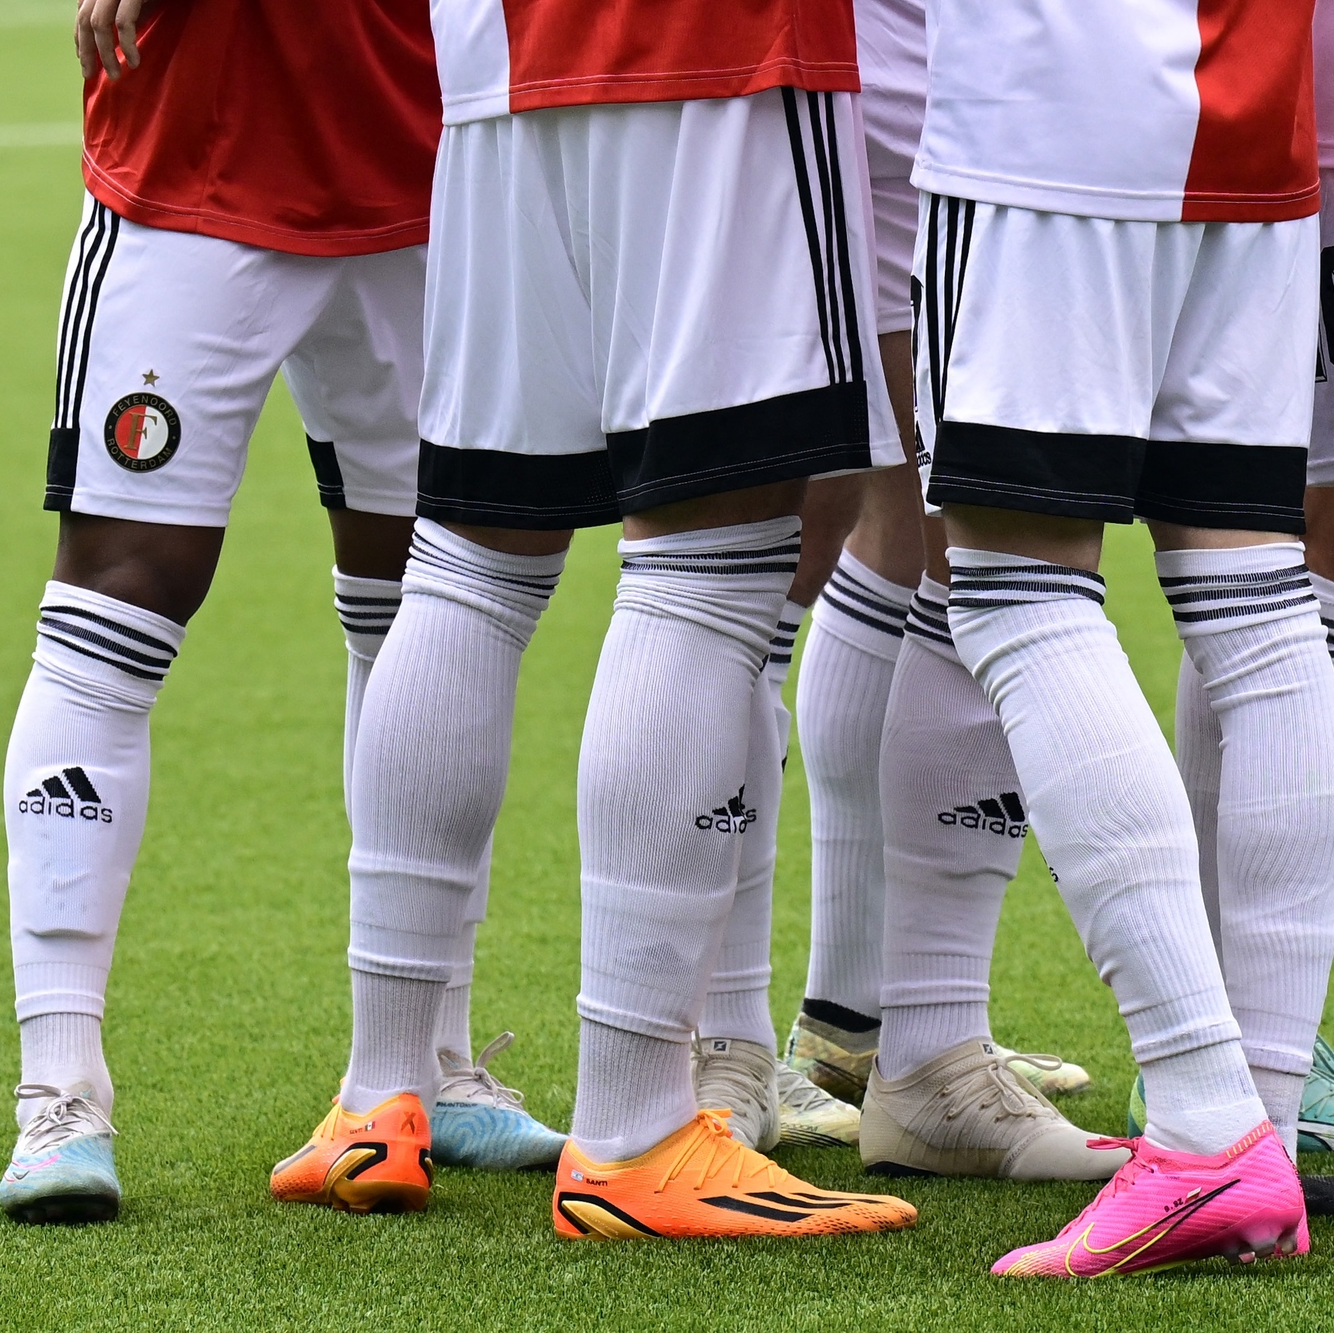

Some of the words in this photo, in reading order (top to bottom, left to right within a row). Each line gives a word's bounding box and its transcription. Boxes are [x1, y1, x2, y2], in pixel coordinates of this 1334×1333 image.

[112, 394, 178, 427] FEYENOORD
[107, 437, 173, 470] ROTTERDAM
[18, 796, 114, 824] adidas
[937, 812, 1029, 839] adidas
[586, 1178, 608, 1187] SANTI
